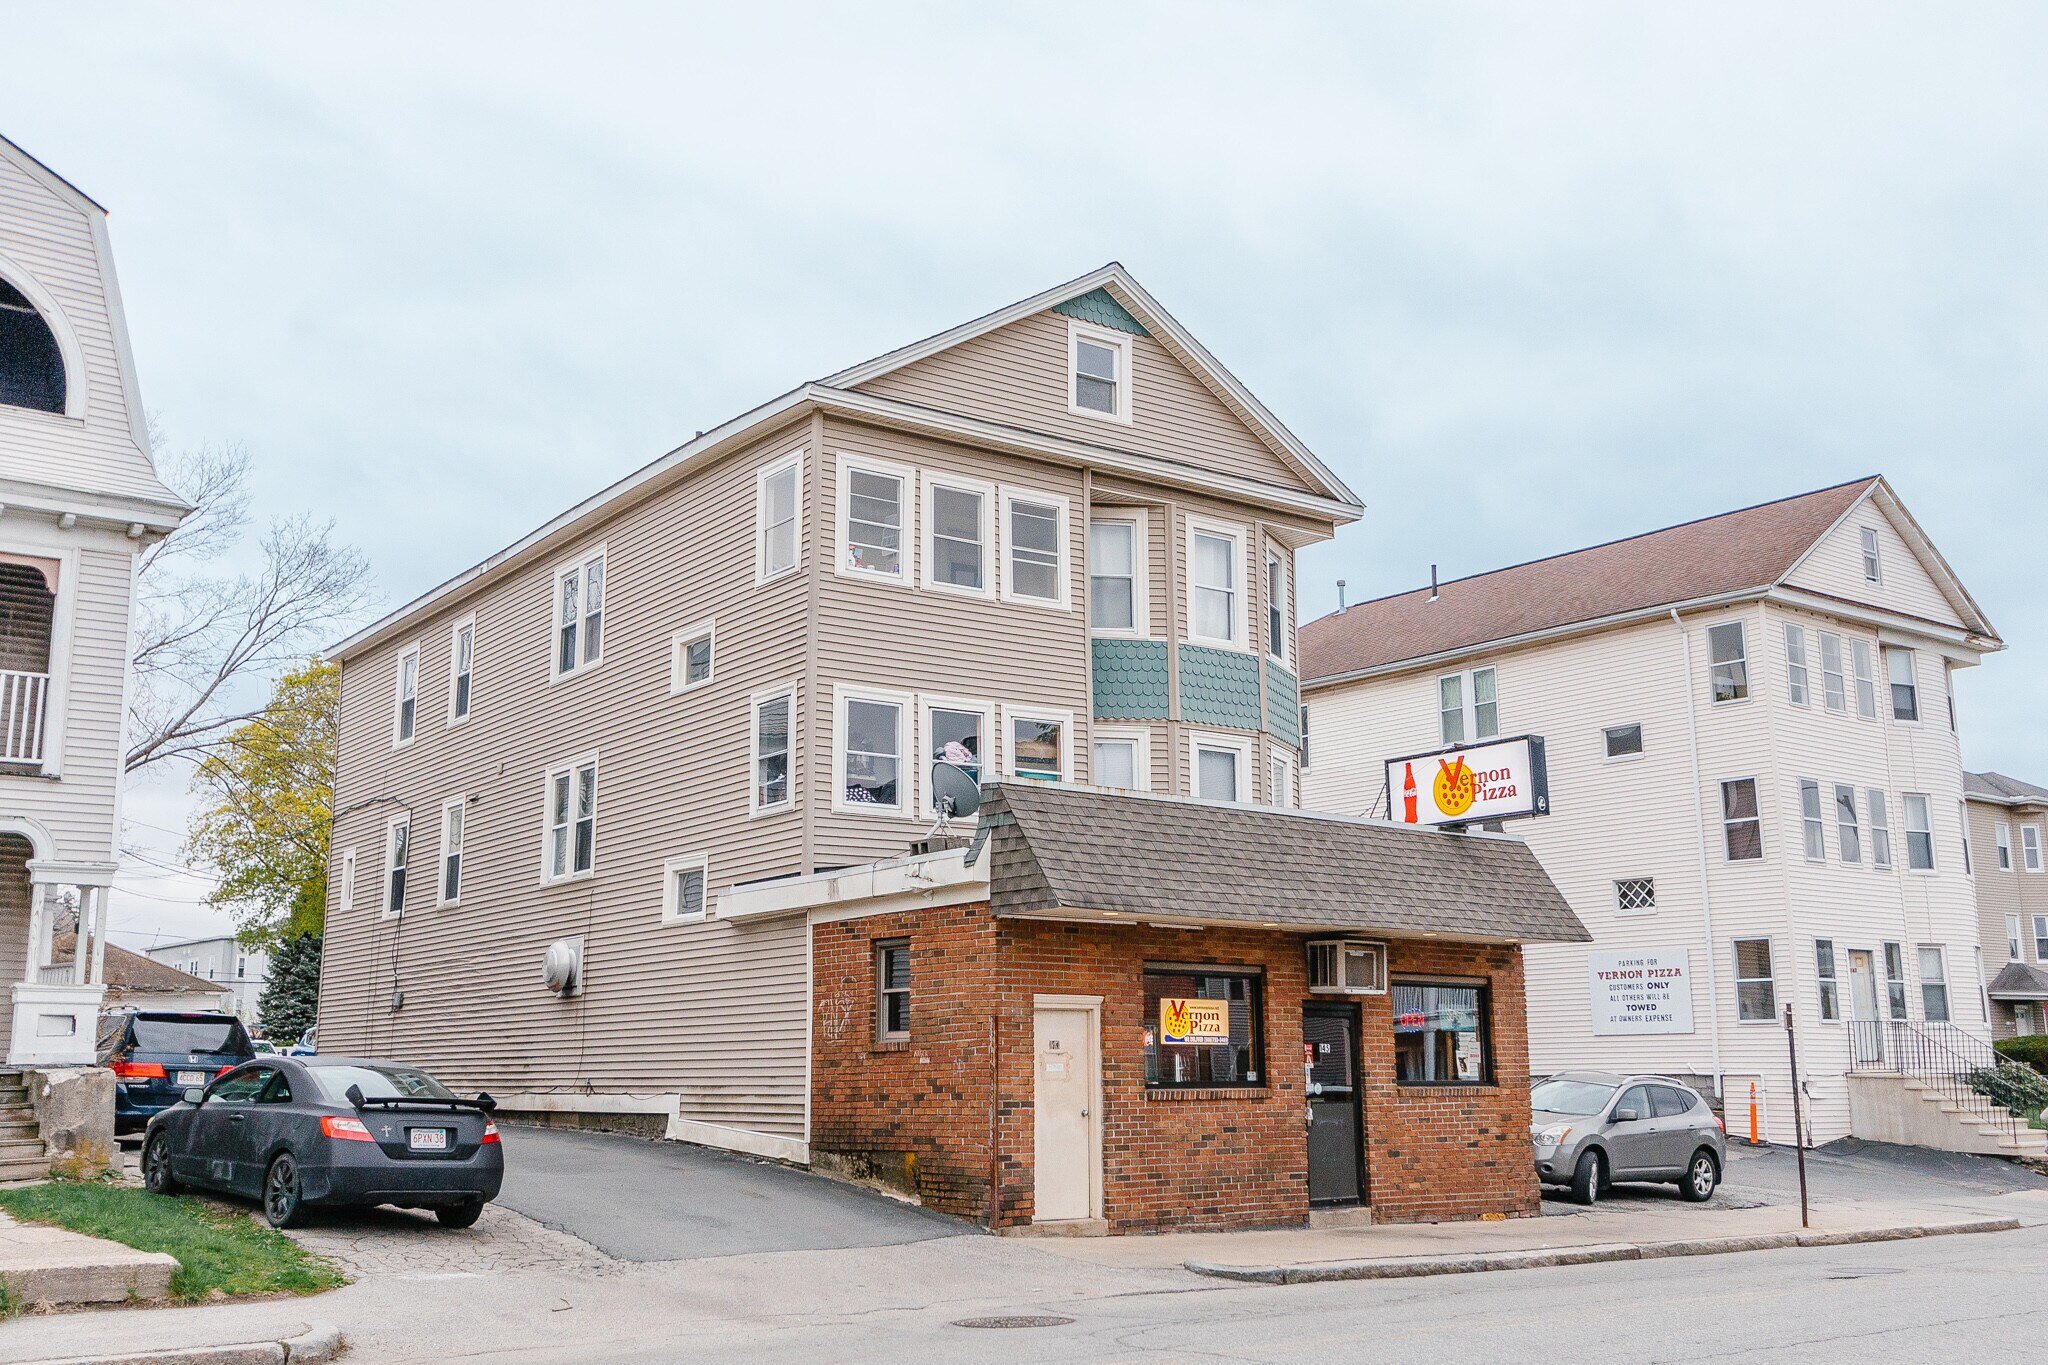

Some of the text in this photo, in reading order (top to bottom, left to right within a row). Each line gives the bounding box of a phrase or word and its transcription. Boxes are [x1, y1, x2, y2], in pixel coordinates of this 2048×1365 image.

[1438, 755, 1511, 792] Vernon
[1471, 782, 1517, 803] Pizza
[1618, 958, 1658, 967] PARKING FOR
[1597, 968, 1682, 980] VERNON PIZZA
[1609, 982, 1670, 991] CUSTOMERS ONLY
[1646, 993, 1661, 1001] WILL
[1171, 1000, 1220, 1022] Vernon
[1626, 1003, 1657, 1012] TOWED
[1400, 1013, 1425, 1027] OPEN
[1610, 1015, 1617, 1023] AT
[1645, 1014, 1673, 1022] EXPENSE
[1190, 1020, 1220, 1034] Pizza
[1319, 1044, 1330, 1053] 145
[413, 1133, 445, 1144] 6PXN 38
